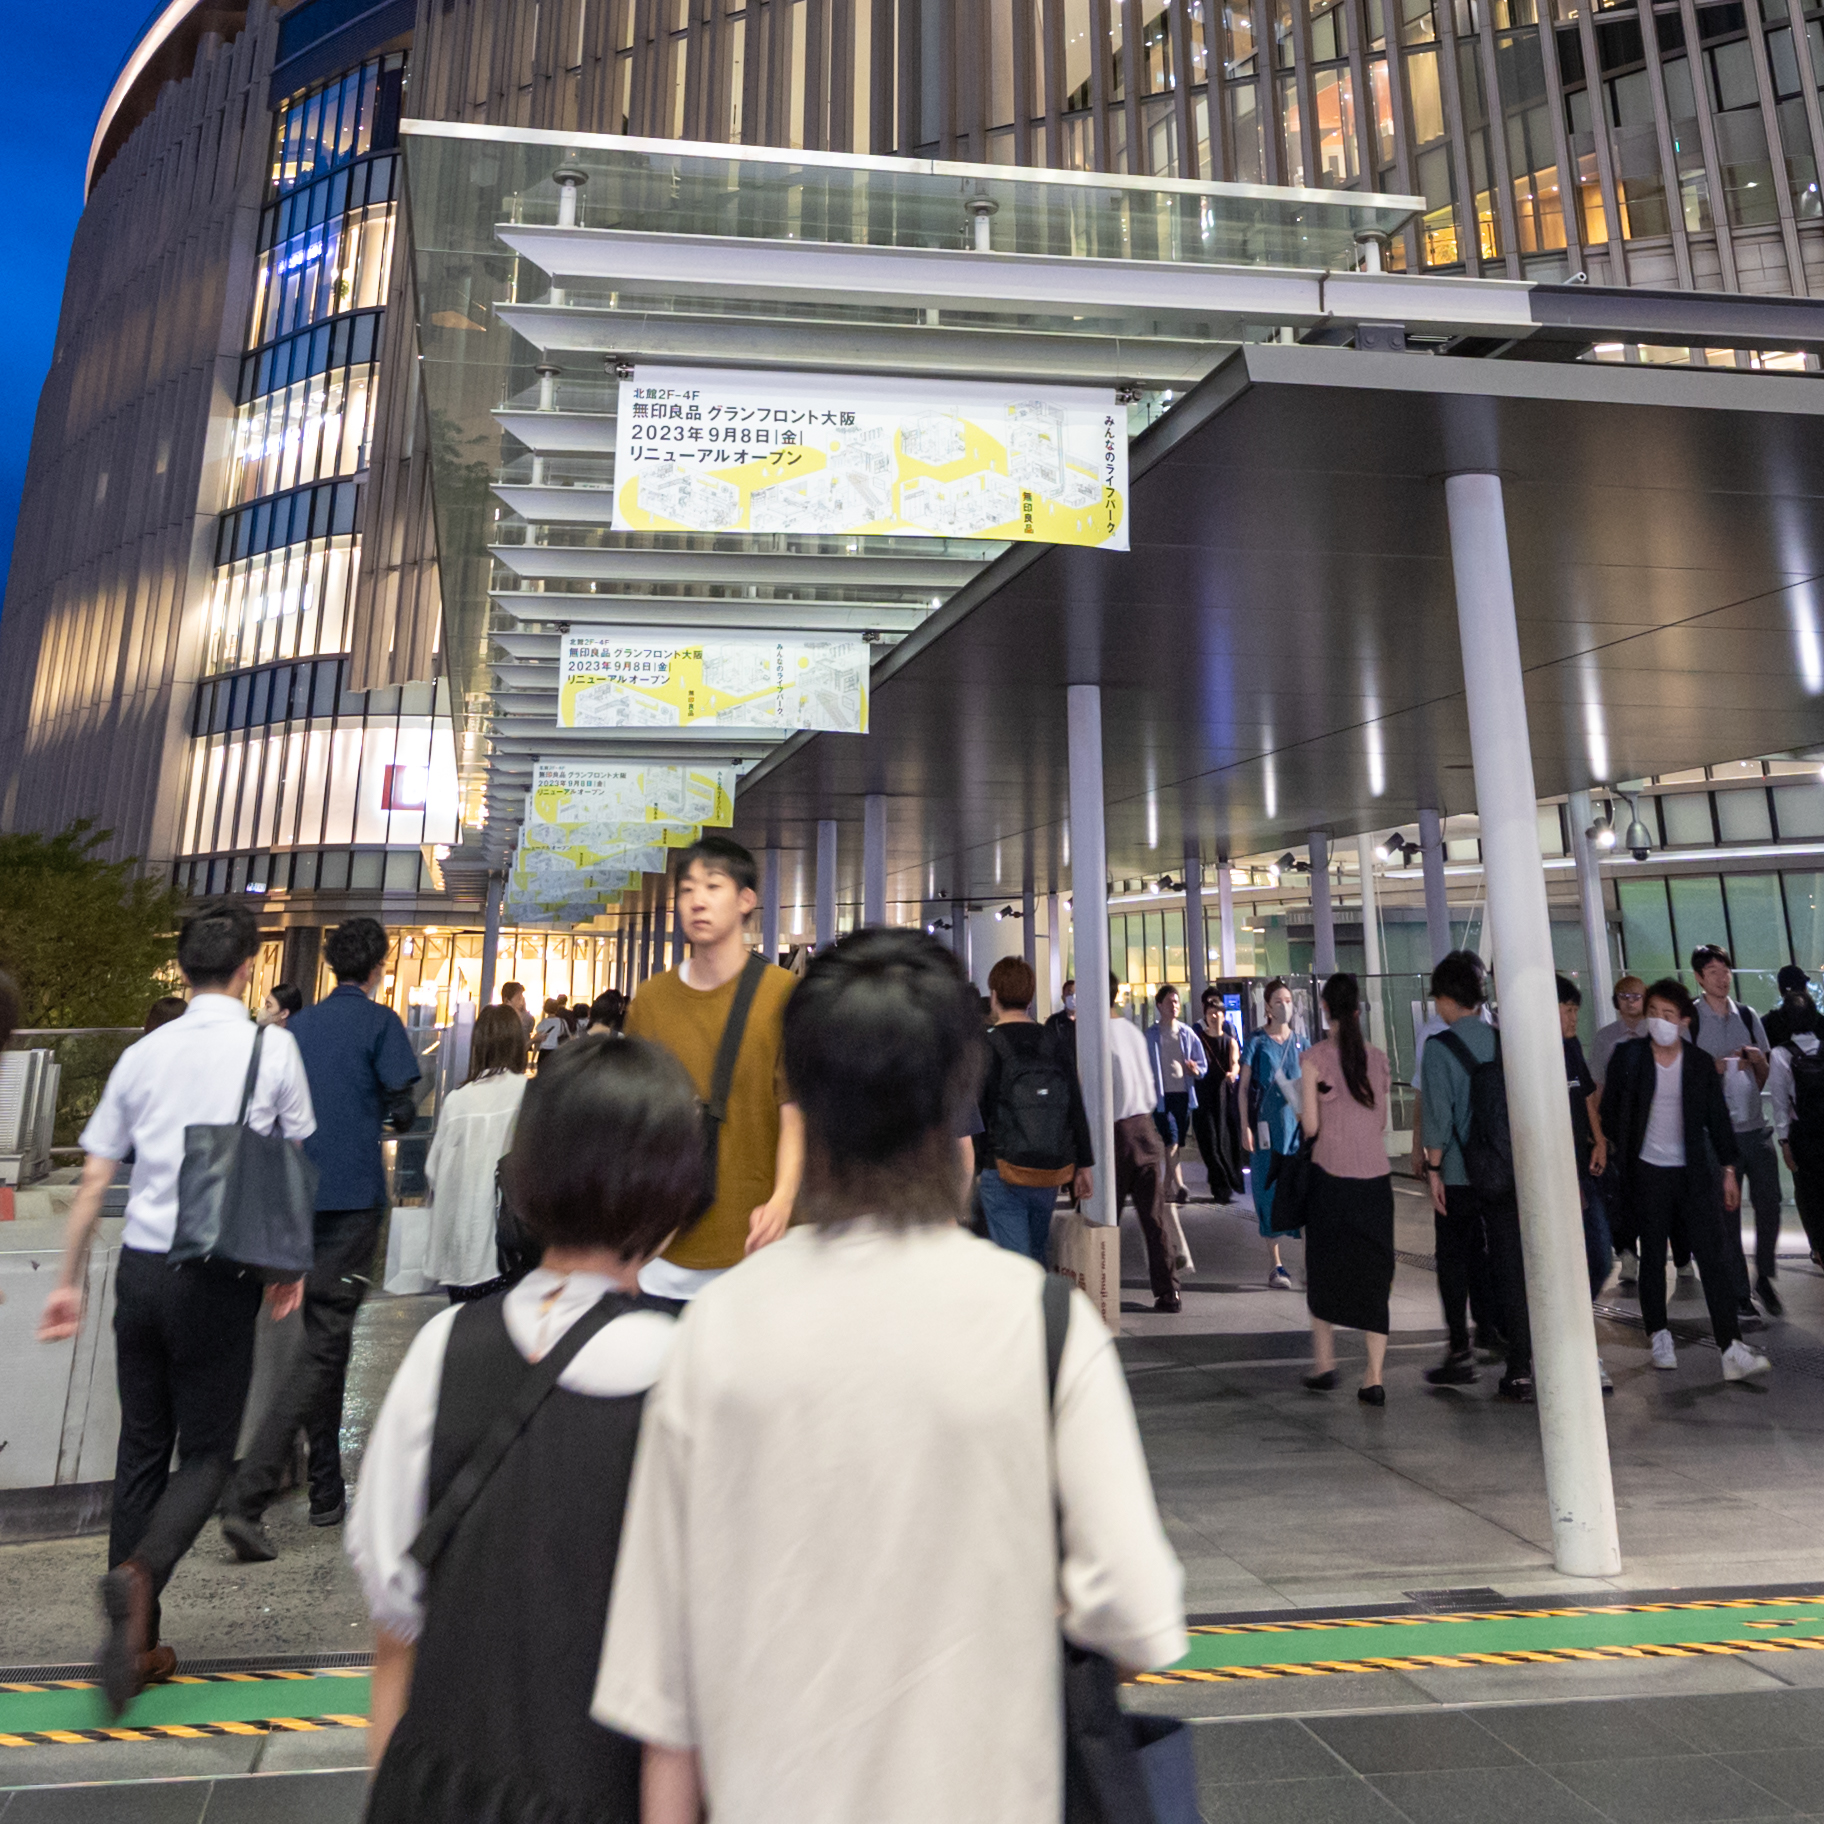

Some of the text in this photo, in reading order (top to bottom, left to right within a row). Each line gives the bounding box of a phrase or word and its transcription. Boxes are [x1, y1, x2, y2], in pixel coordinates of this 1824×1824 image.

[632, 402, 856, 426] 無印良品 グランフロント大阪
[1022, 492, 1034, 534] 無印良品
